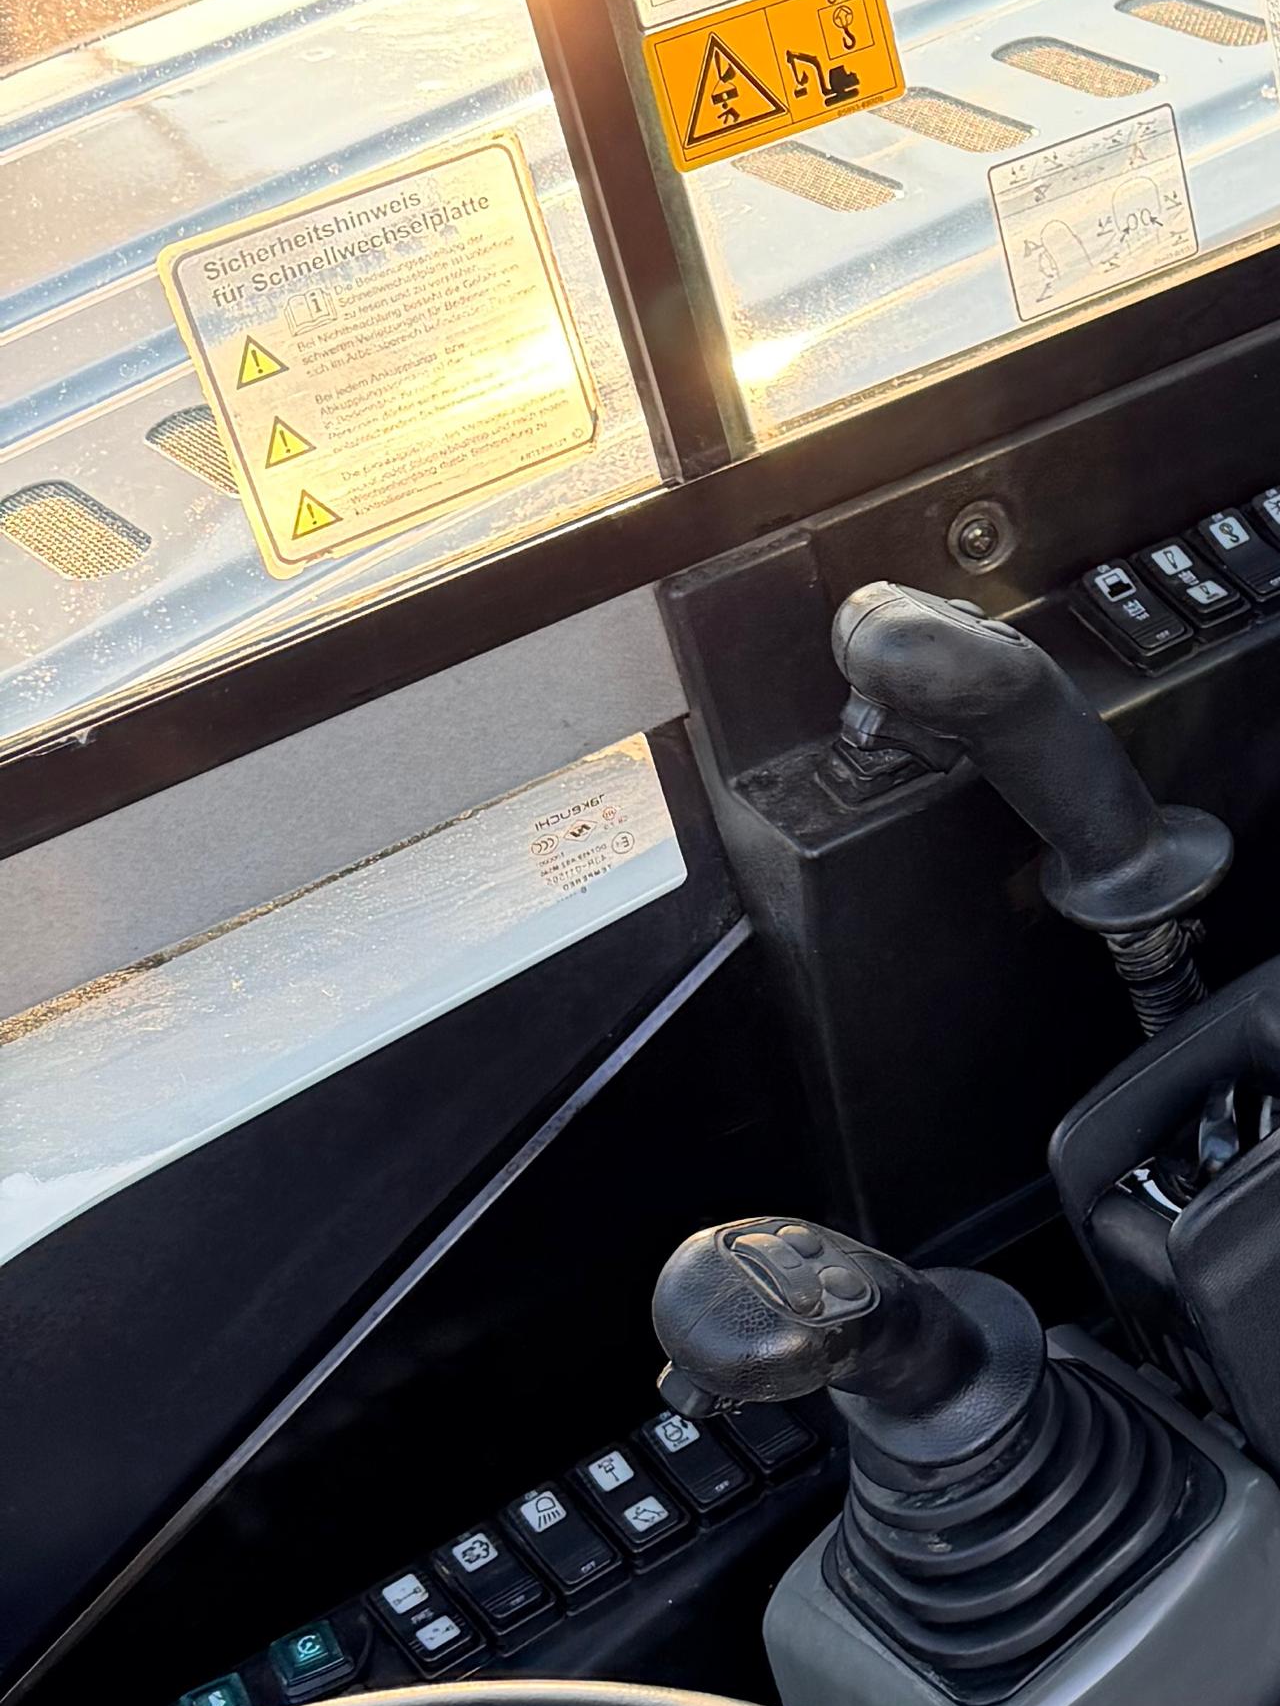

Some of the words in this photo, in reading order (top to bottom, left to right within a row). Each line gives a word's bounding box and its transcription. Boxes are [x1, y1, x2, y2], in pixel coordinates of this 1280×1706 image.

[200, 189, 423, 282] Sicherheitshinweis
[210, 280, 248, 308] für
[248, 192, 492, 293] Schnellwechselplatte
